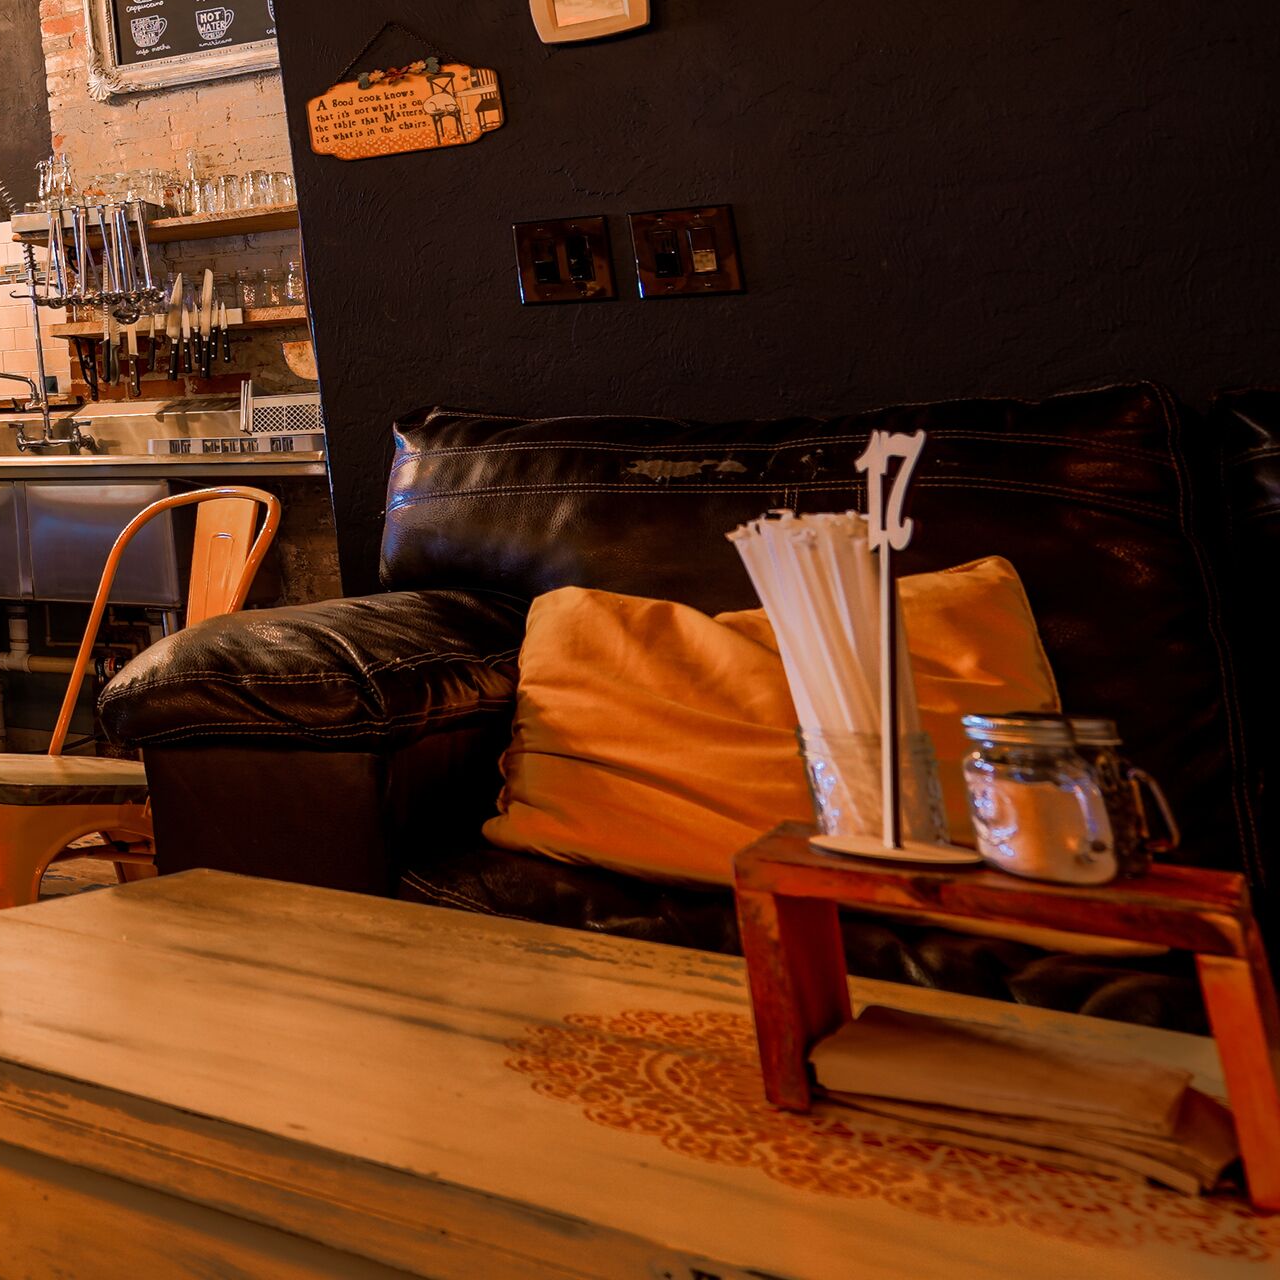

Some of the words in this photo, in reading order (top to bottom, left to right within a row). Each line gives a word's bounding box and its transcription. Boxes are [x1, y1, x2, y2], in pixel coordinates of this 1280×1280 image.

[197, 20, 226, 33] WATER
[199, 11, 221, 23] HOT
[316, 100, 327, 112] A
[358, 94, 382, 104] cook
[384, 89, 415, 101] knows
[316, 113, 334, 123] that
[337, 111, 350, 120] it's
[354, 106, 370, 116] not
[371, 102, 394, 114] what
[399, 101, 407, 110] is
[411, 99, 423, 107] on
[315, 124, 329, 133] the
[333, 120, 357, 130] table
[361, 116, 379, 126] that
[316, 134, 330, 144] it's
[332, 130, 354, 141] what
[355, 128, 364, 138] is
[366, 128, 376, 137] in
[380, 125, 394, 134] the
[398, 120, 431, 131] chairs.
[854, 428, 926, 551] 17
